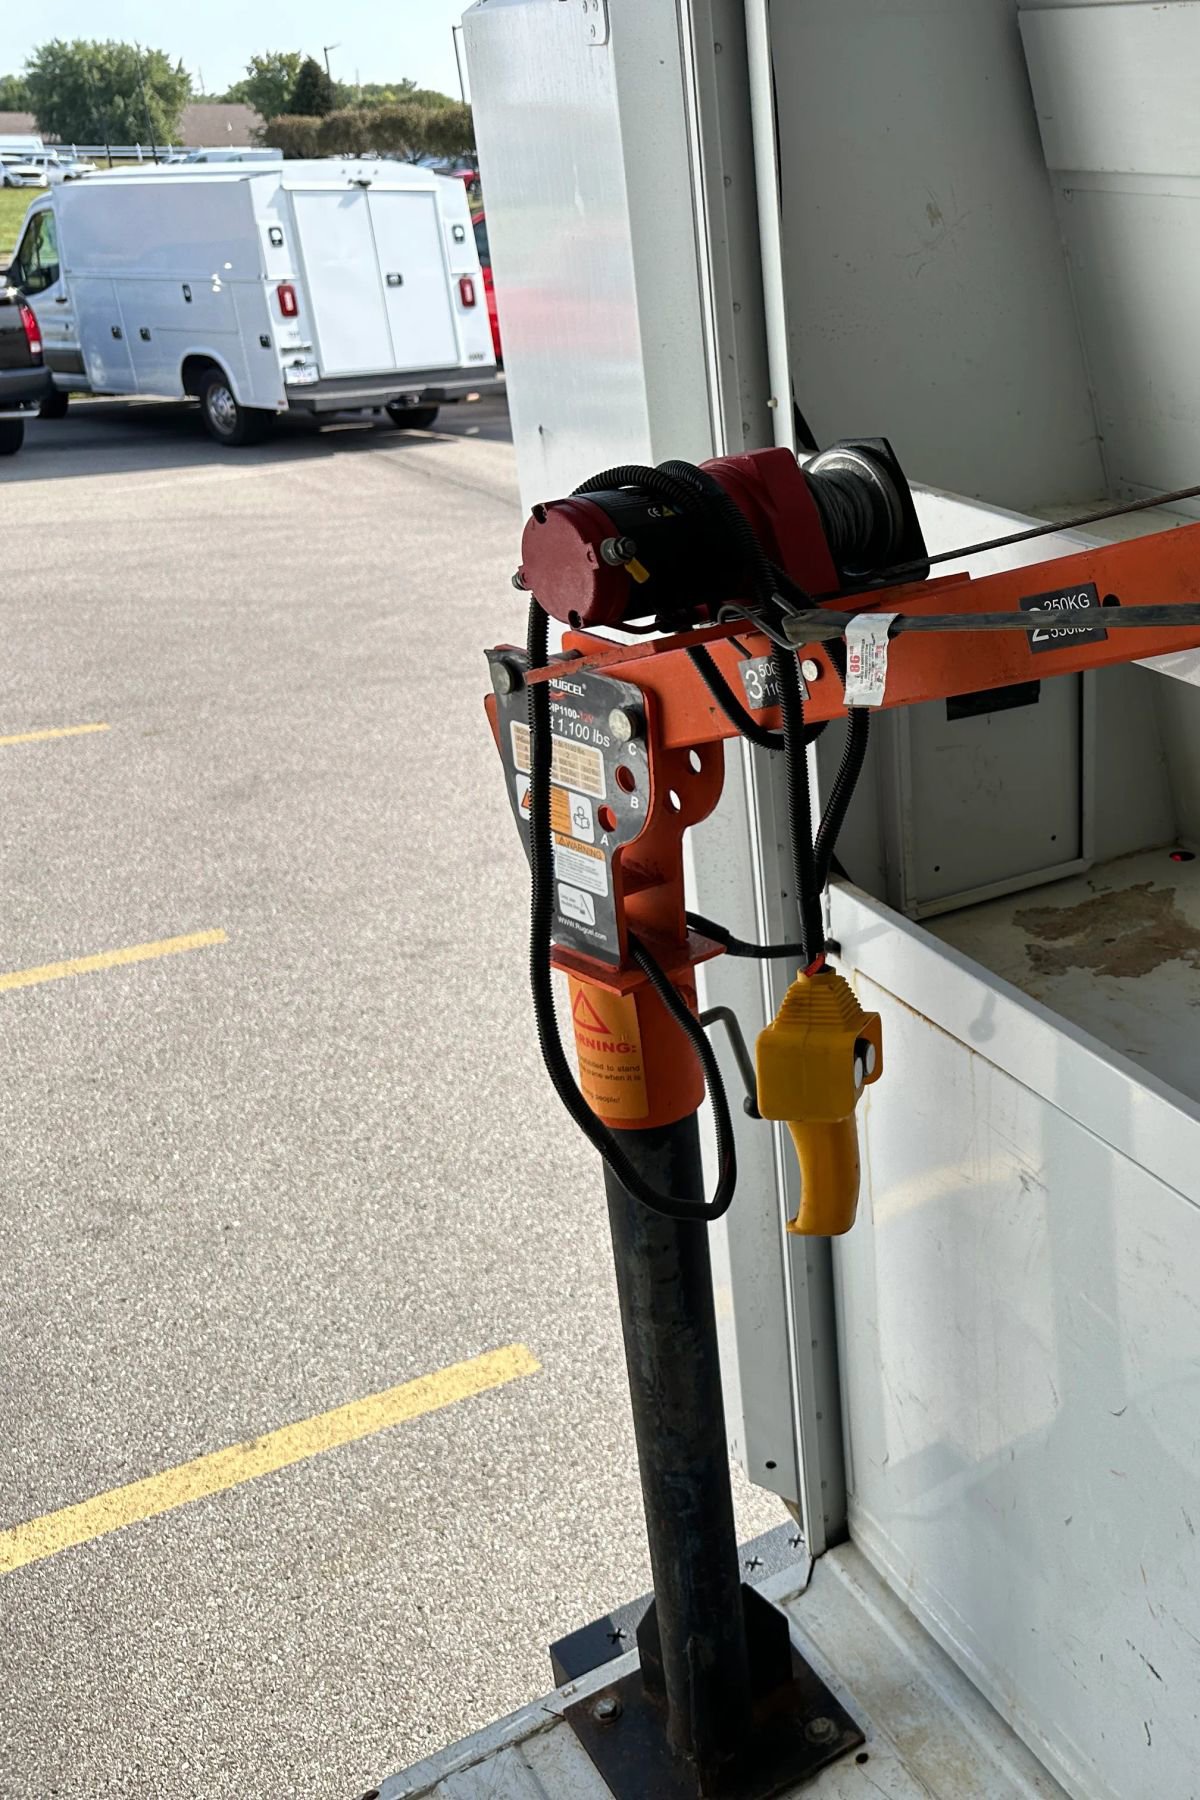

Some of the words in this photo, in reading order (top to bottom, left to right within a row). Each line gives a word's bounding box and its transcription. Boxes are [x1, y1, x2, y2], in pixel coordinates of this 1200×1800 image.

[1043, 592, 1090, 612] 250KG
[849, 655, 861, 673] 86
[745, 669, 764, 700] 3
[558, 718, 590, 741] 1,100
[592, 729, 611, 748] lbs
[628, 742, 637, 756] C
[630, 796, 640, 809] B
[564, 839, 604, 860] WARNING
[600, 833, 610, 847] A
[576, 1032, 638, 1054] RNING:
